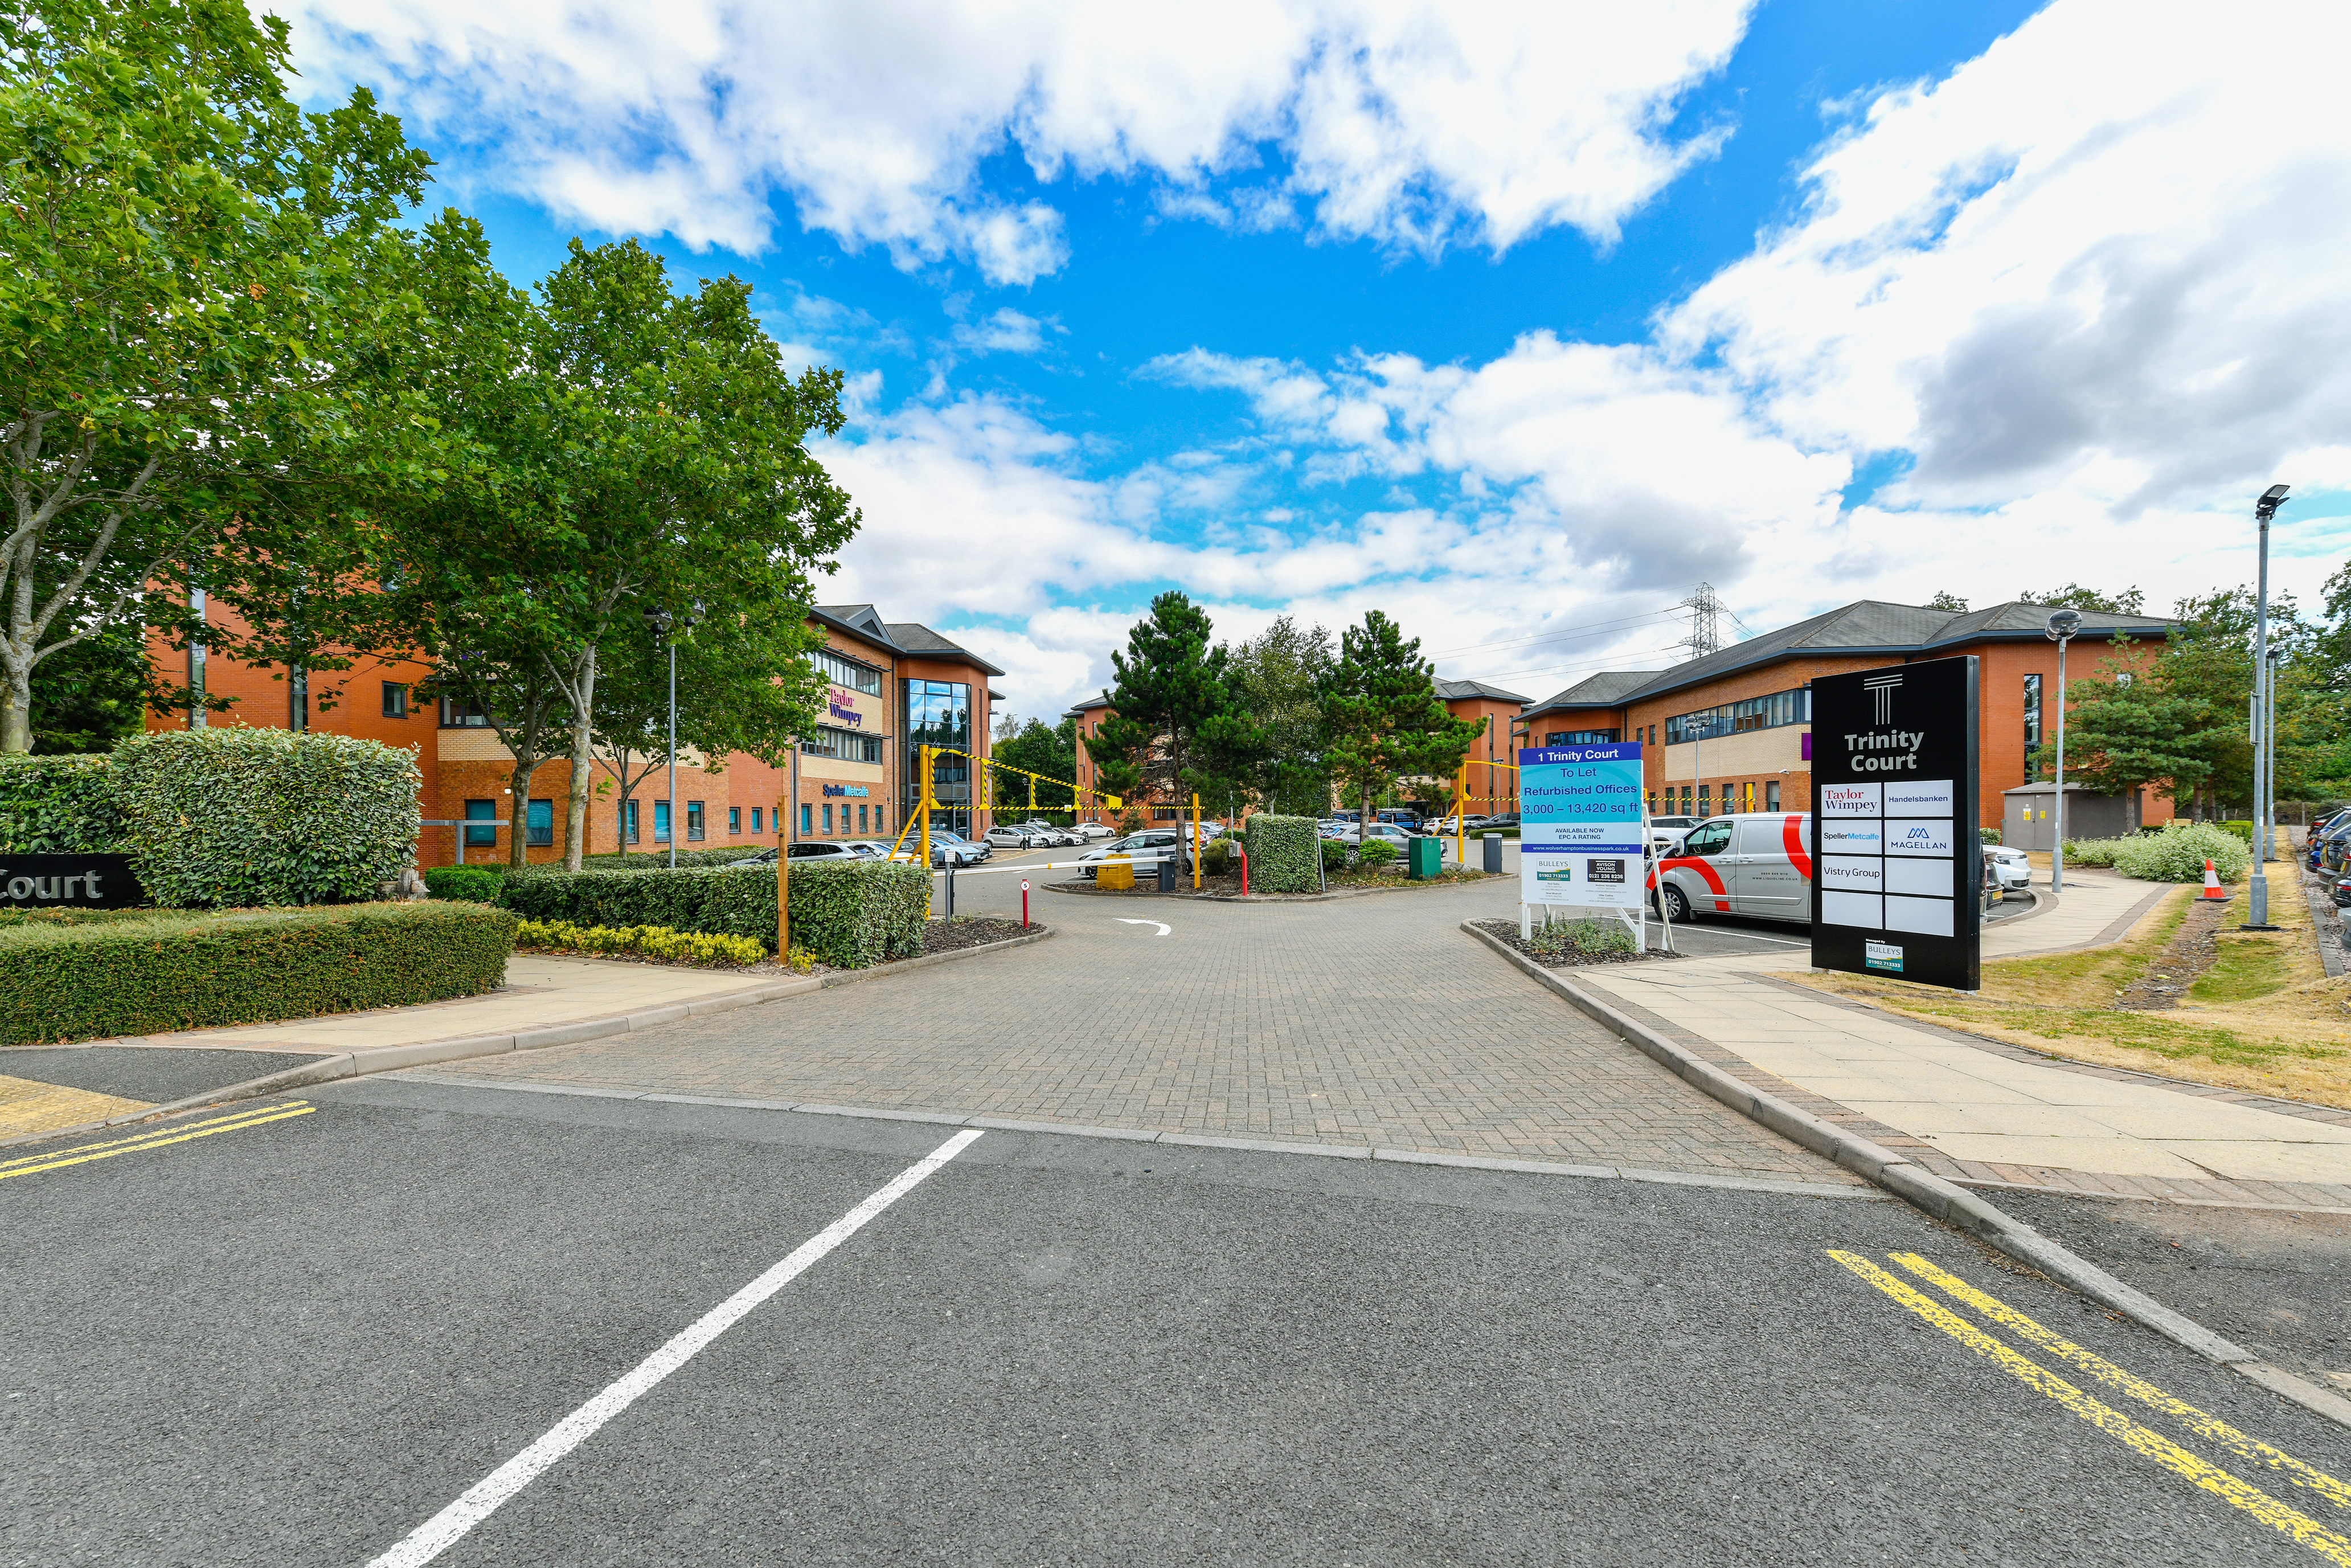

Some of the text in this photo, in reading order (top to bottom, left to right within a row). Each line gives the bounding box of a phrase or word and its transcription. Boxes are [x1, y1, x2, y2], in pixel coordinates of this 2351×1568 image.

[829, 687, 855, 708] Taylor
[829, 703, 862, 727] Wimpey
[1844, 729, 1924, 752] Trinity
[1538, 749, 1619, 762] 1 Trinity Court
[1851, 753, 1917, 772] Court
[1560, 767, 1596, 777] To Let
[1524, 785, 1637, 796] Refurbished Offices
[1825, 788, 1864, 802] Taylor
[1523, 804, 1554, 814] 3,000
[1567, 803, 1607, 814] 13,420
[1611, 805, 1625, 814] sq
[1629, 803, 1638, 812] ft
[1825, 800, 1877, 813] Wimpey
[1824, 867, 1880, 879] Vistry Group
[1869, 946, 1901, 955] BULLEYS
